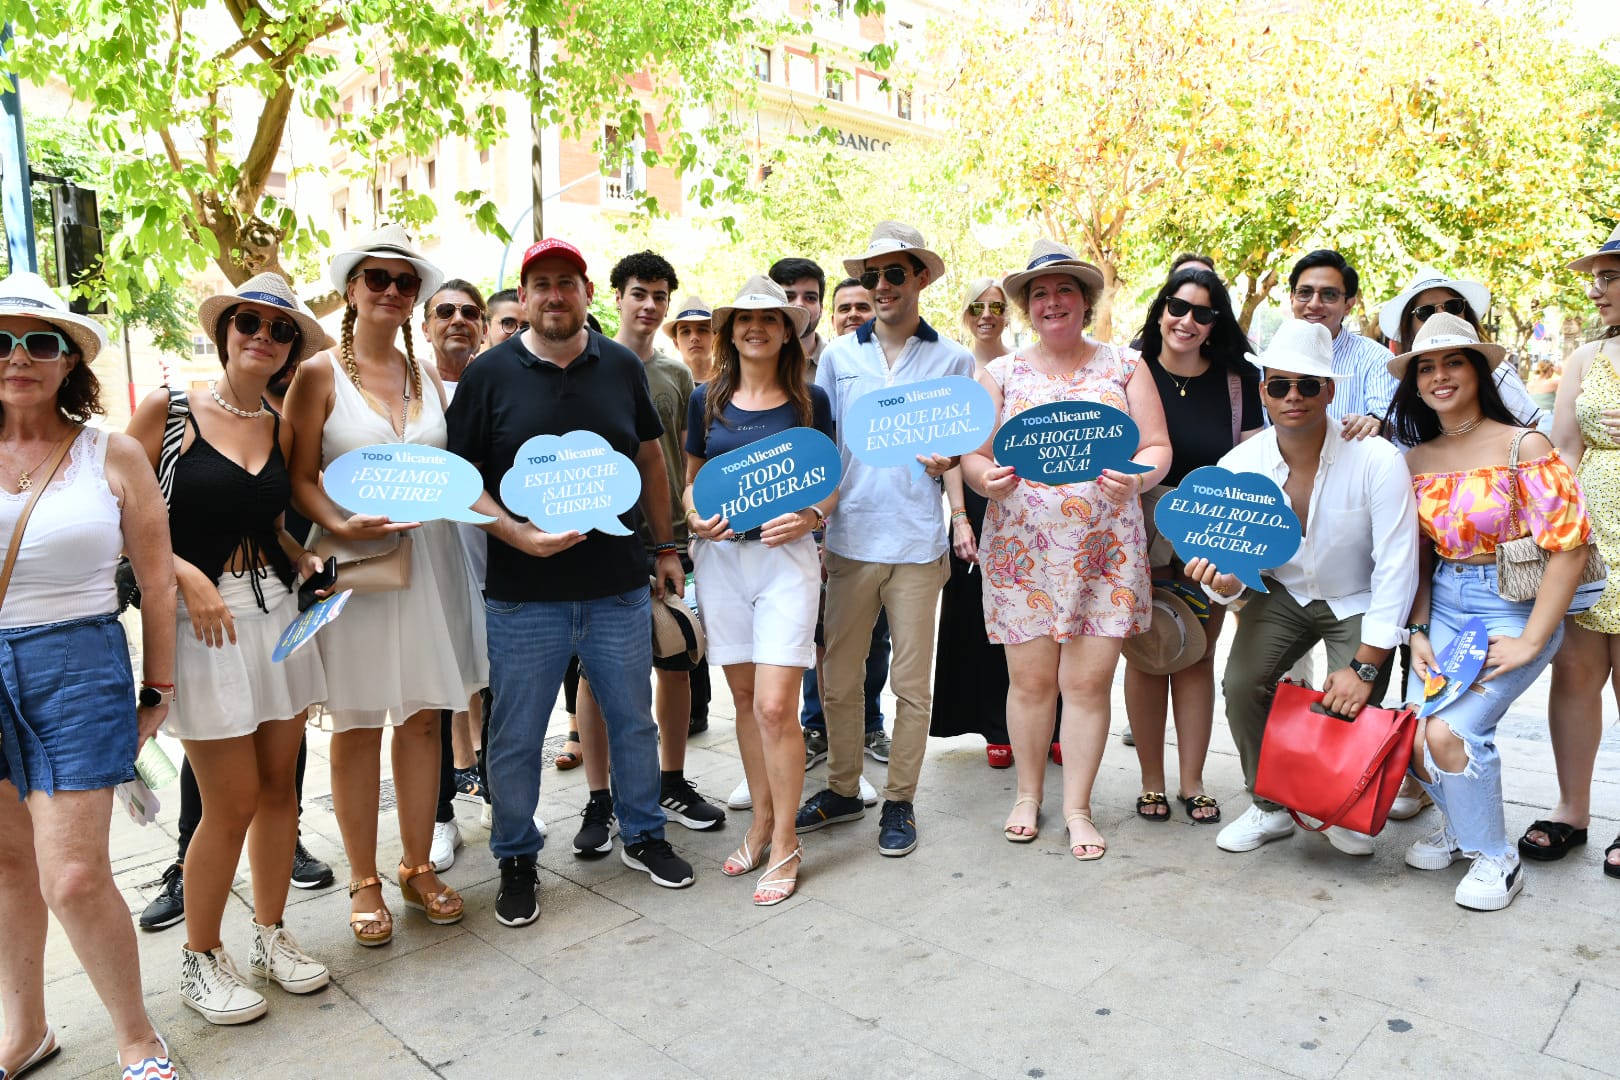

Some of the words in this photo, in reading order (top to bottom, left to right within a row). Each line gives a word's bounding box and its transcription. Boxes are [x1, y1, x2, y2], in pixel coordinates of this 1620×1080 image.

[868, 416, 892, 434] LO
[894, 408, 929, 433] QUE
[930, 401, 971, 422] PASA
[866, 434, 889, 450] EN
[892, 427, 924, 446] SAN
[925, 419, 980, 443] JUAN...
[1004, 433, 1038, 451] ¡LAS
[1040, 424, 1123, 445] HOGUERAS
[1038, 445, 1070, 460] SON
[1070, 443, 1092, 457] LA
[351, 467, 450, 485] ¡ESTAMOS
[524, 471, 560, 488] ESTA
[561, 462, 619, 483] NOCHE
[737, 457, 795, 497] ¡TODO
[1042, 457, 1091, 474] CAÑA!
[358, 484, 391, 500] ON
[390, 487, 443, 503] FIRE!
[541, 479, 606, 505] ¡SALTAN
[721, 466, 826, 520] HOGUERAS!
[544, 495, 613, 517] CHISPAS!
[1168, 498, 1190, 513] EL
[1190, 502, 1227, 519] MAL
[1227, 505, 1290, 530] ROLLO...
[1204, 521, 1223, 534] ¡A
[1223, 523, 1247, 537] LA
[1183, 531, 1268, 556] HOGUERA!
